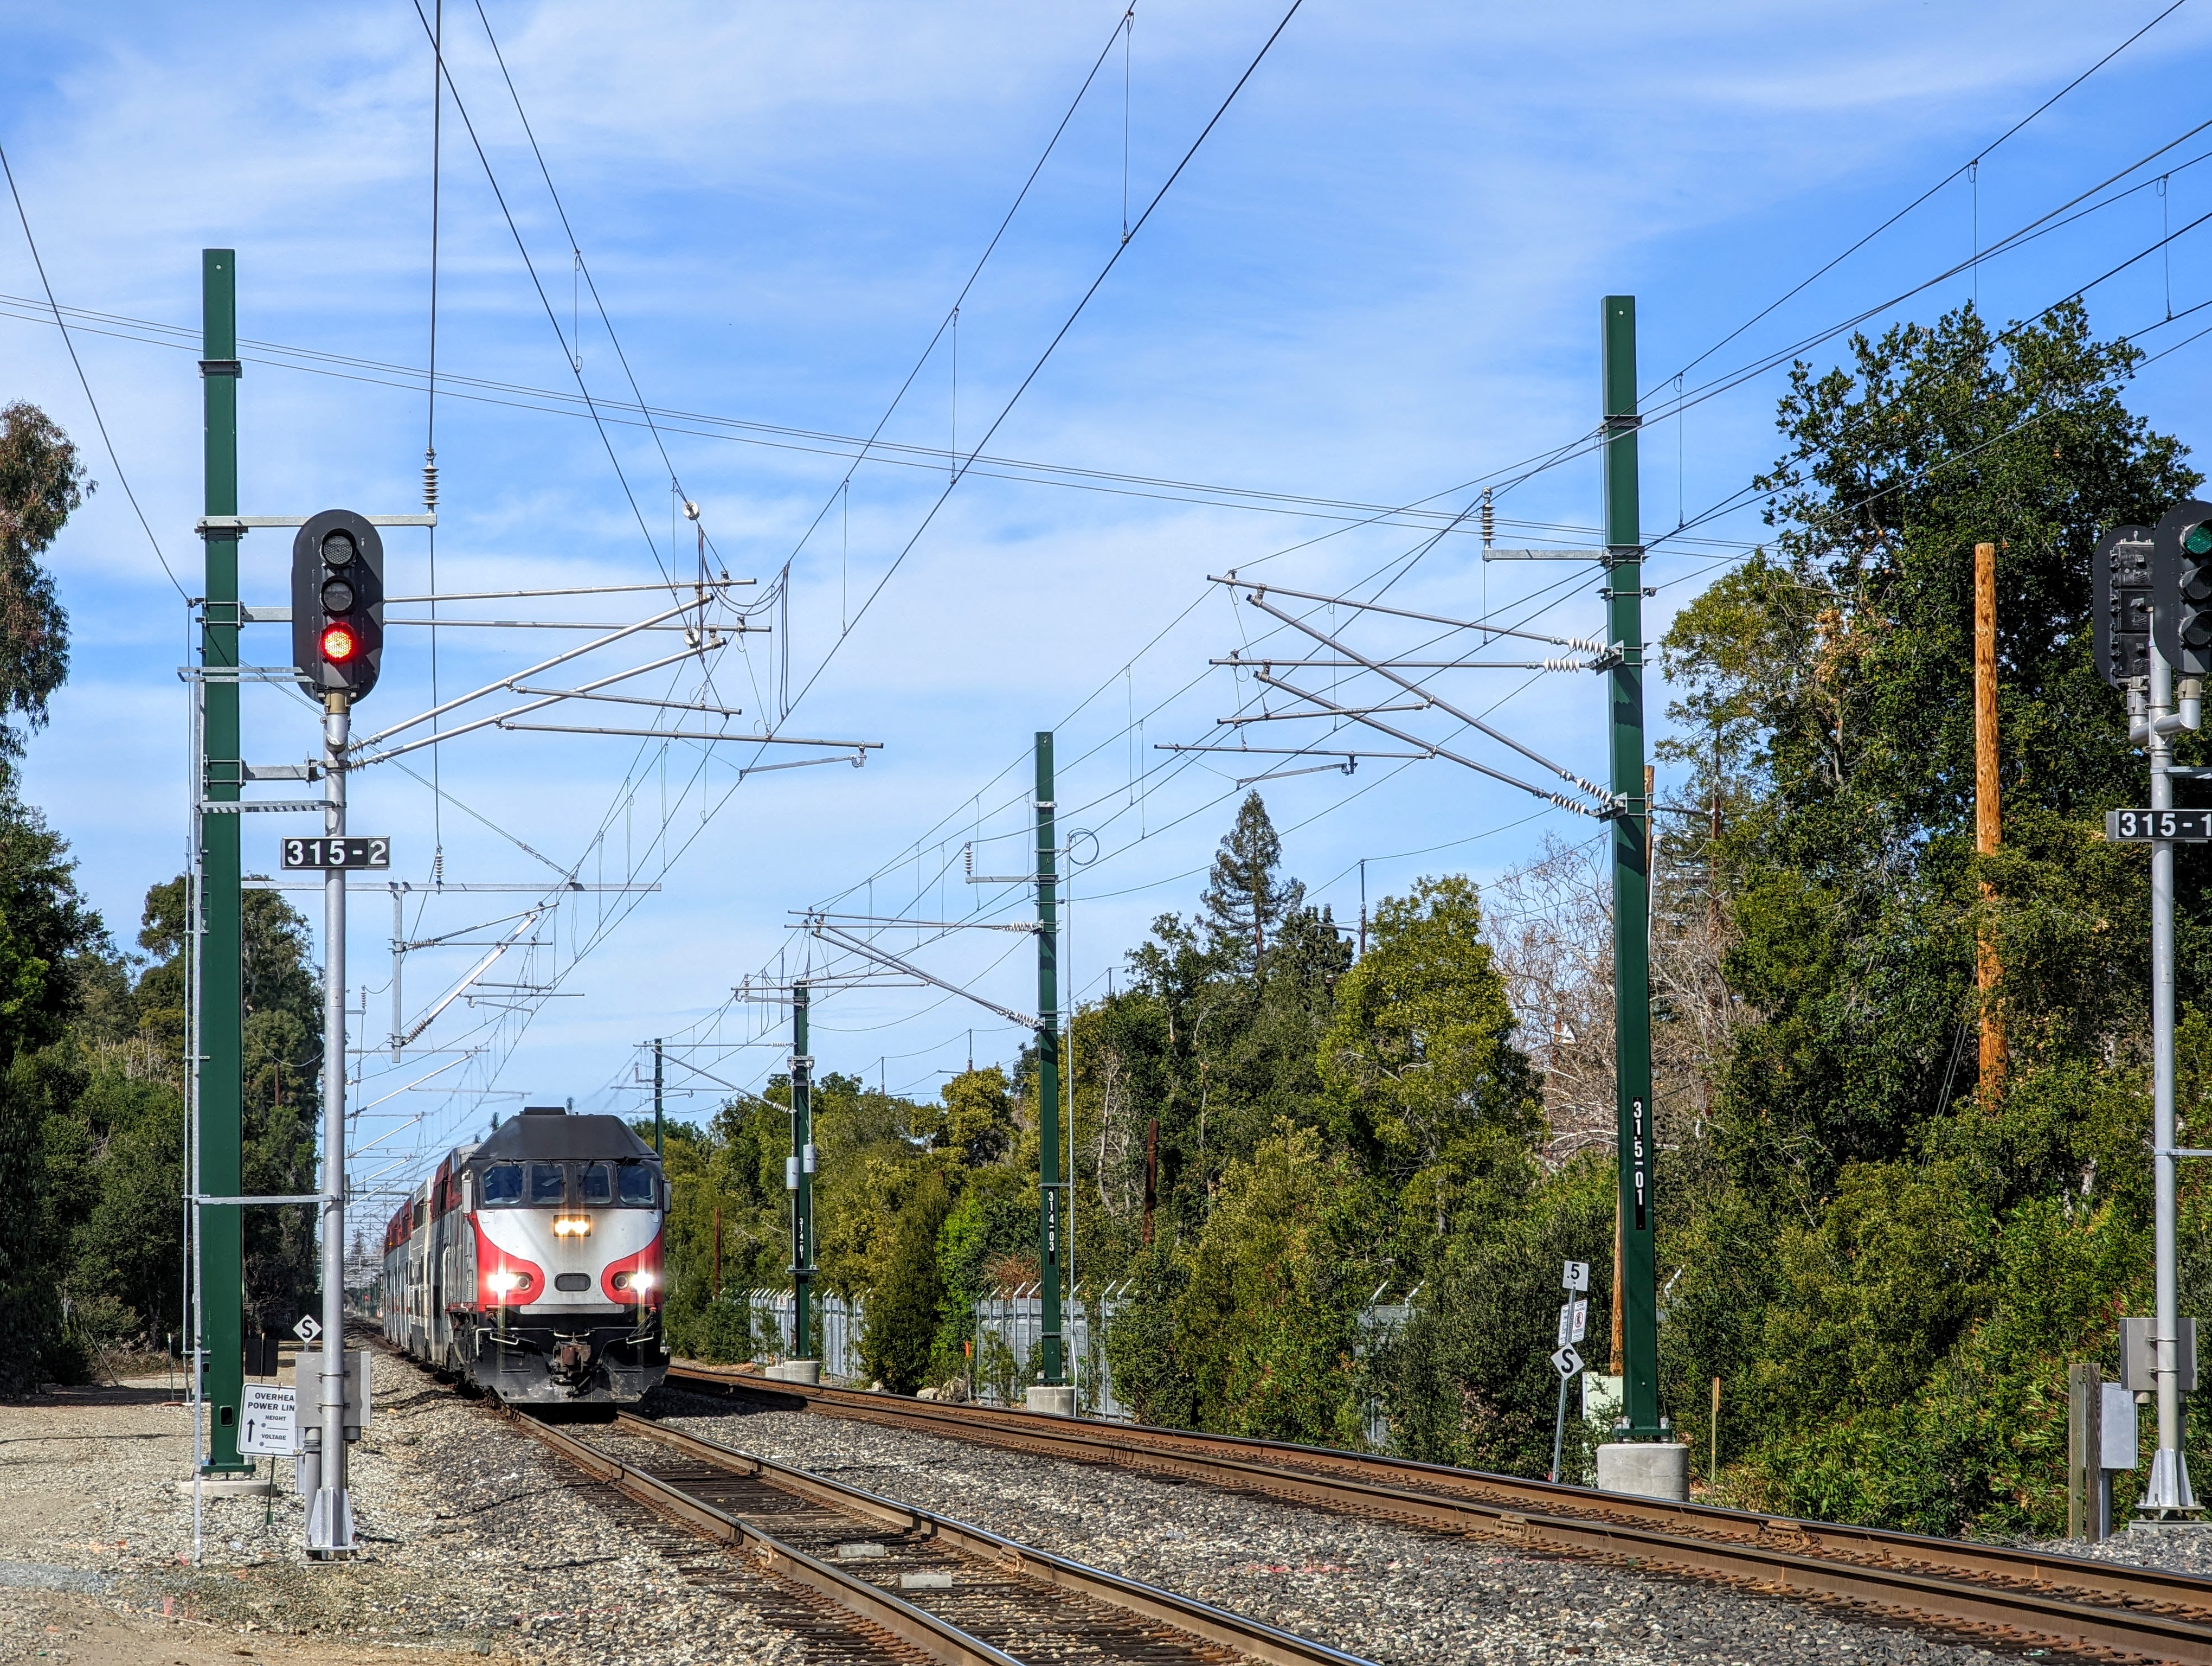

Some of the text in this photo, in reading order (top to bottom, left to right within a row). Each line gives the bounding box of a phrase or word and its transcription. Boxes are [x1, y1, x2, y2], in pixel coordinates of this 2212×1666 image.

[2121, 812, 2212, 836] 315-1
[287, 840, 387, 865] 315-2
[1633, 1101, 1644, 1205] 31.5-01
[1567, 1263, 1580, 1280] .5
[301, 1319, 313, 1338] S
[1561, 1348, 1574, 1374] S
[247, 1401, 295, 1412] POWER LIN
[255, 1392, 294, 1402] OVERHEA
